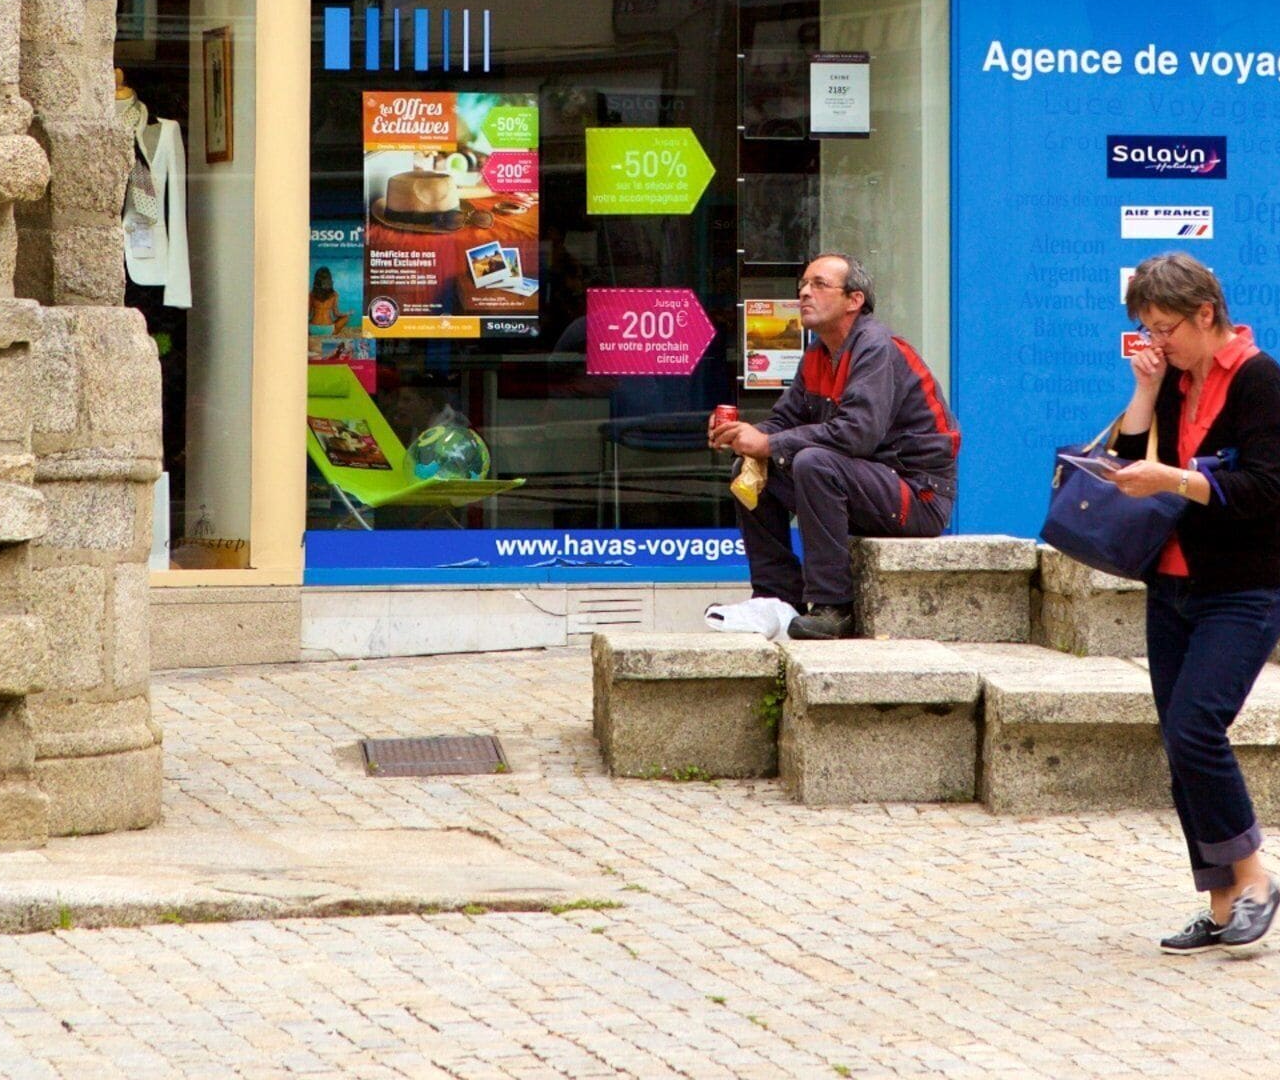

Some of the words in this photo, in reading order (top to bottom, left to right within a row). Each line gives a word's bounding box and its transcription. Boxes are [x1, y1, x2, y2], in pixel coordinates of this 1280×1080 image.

[982, 40, 1122, 81] Agence
[1134, 43, 1179, 75] de
[392, 98, 443, 120] Offres
[372, 116, 450, 134] Exclusives
[490, 116, 529, 132] -50%
[610, 150, 688, 178] -50%
[676, 181, 688, 190] de
[1125, 209, 1149, 217] AIR
[1154, 209, 1210, 217] FRANCE
[309, 226, 345, 241] asso
[411, 250, 421, 258] de
[370, 259, 393, 267] Offres
[394, 259, 431, 267] Exclusives
[654, 299, 689, 309] Jusqu'à
[608, 310, 688, 339] -200€
[600, 342, 616, 351] sur
[617, 341, 643, 351] votre
[645, 341, 689, 352] prochain
[656, 353, 689, 363] circuit
[495, 533, 746, 561] www.havas-voyages
